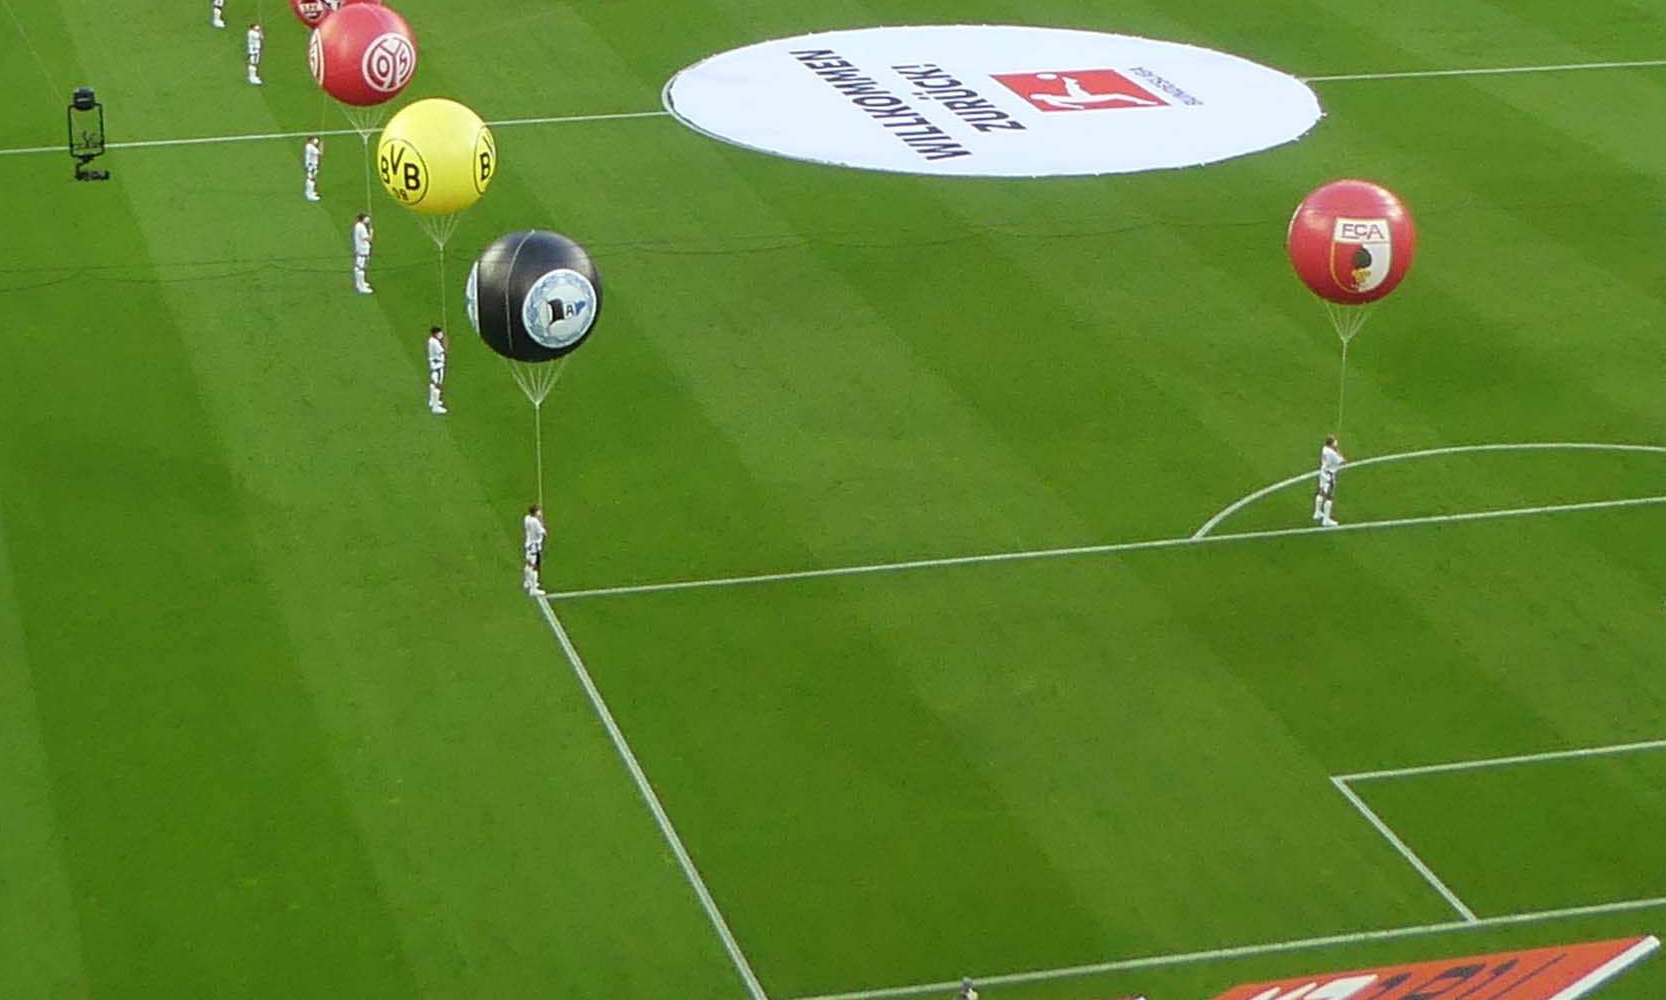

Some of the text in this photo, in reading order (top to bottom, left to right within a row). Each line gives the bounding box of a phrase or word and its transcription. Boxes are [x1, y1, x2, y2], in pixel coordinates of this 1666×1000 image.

[789, 49, 972, 161] WILLKOMMEN
[890, 63, 1027, 133] ZURÜCK!
[381, 143, 420, 190] BVB
[1341, 223, 1385, 240] FCA
